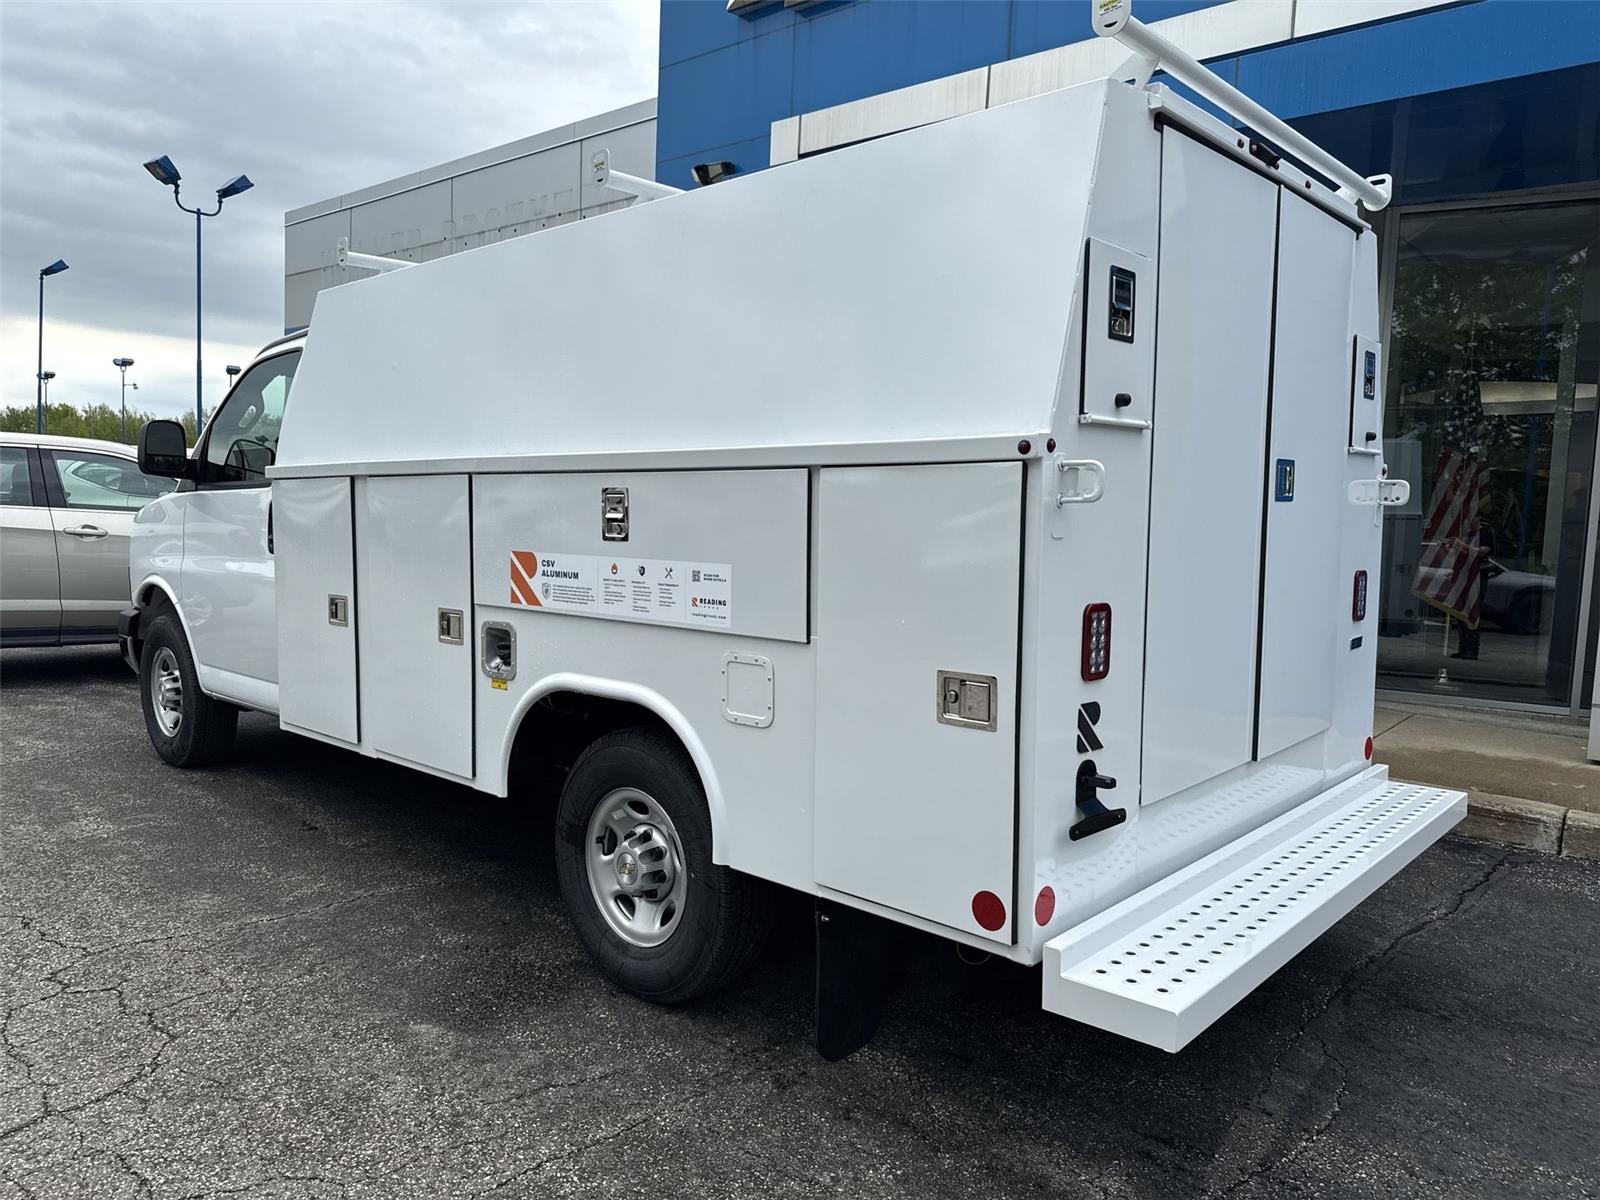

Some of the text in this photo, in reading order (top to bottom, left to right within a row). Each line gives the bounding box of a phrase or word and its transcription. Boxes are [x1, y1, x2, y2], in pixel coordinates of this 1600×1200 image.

[541, 559, 556, 568] CSV
[541, 569, 579, 580] ALUMINUM
[699, 597, 727, 607] READING
